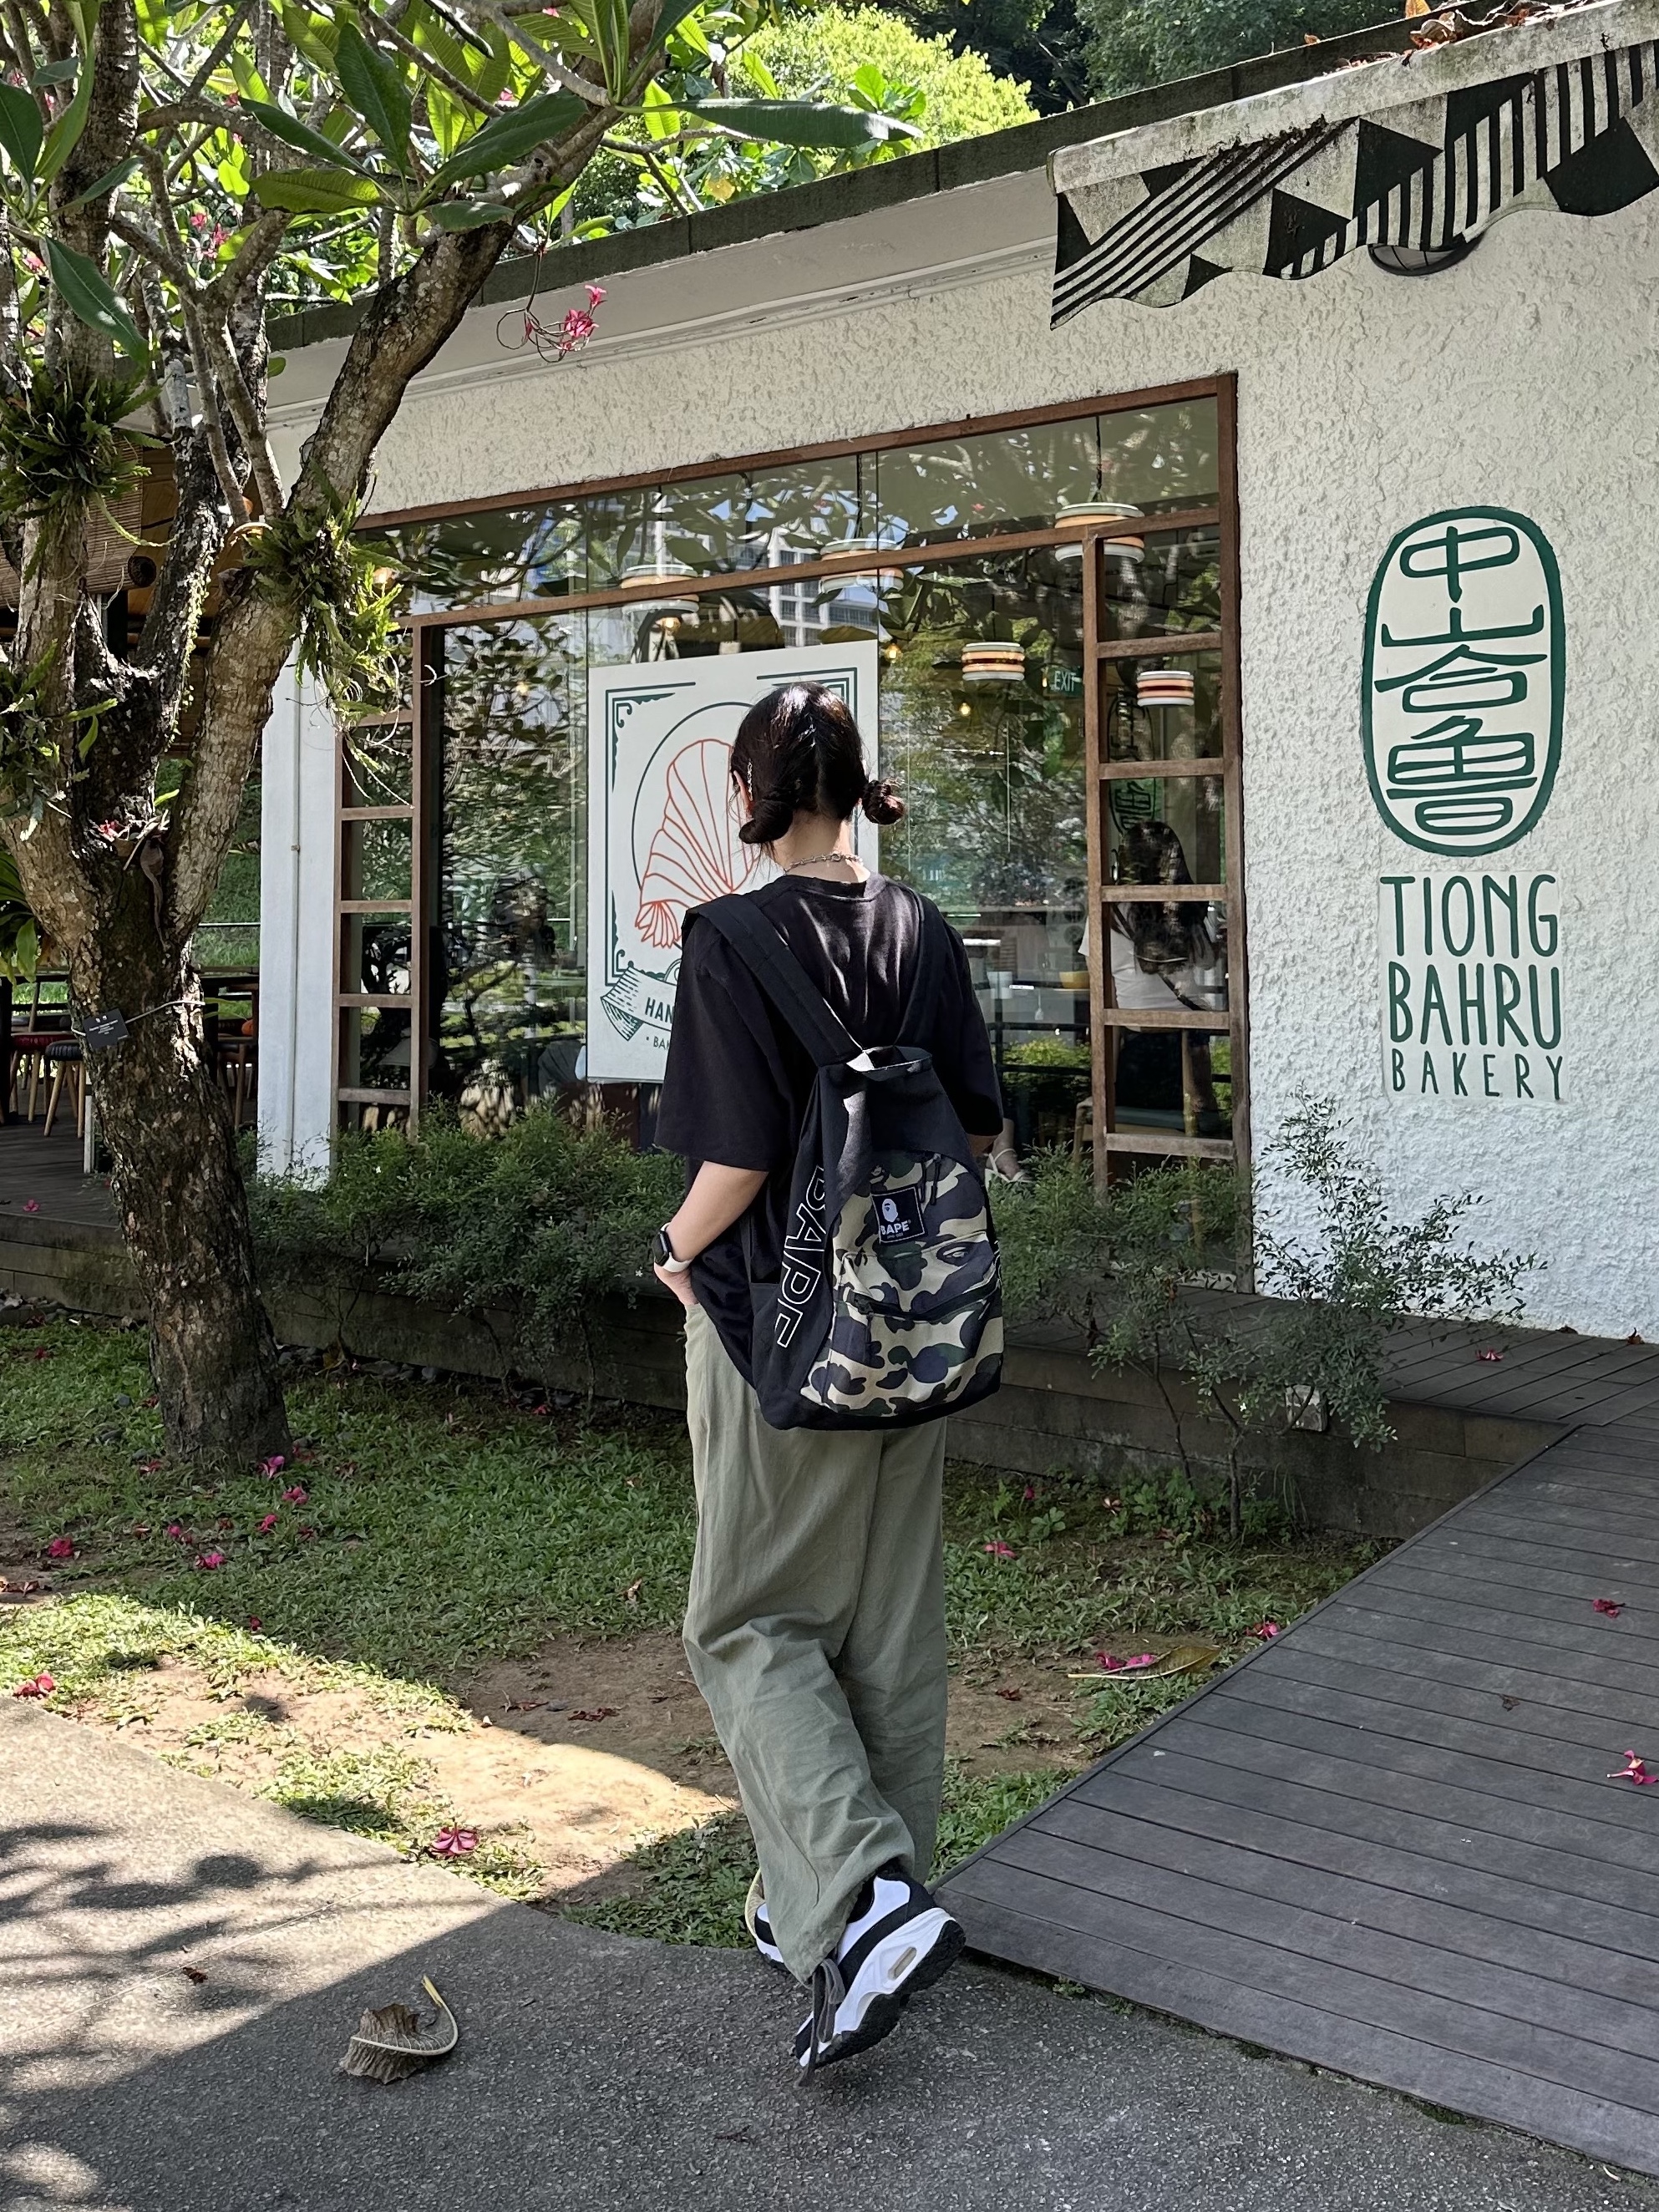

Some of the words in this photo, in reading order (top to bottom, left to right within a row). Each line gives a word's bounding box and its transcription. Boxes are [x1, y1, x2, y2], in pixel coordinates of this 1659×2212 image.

[1054, 670, 1077, 692] EXIT
[1380, 875, 1559, 960] TIONG
[1388, 961, 1562, 1051] BAHRU
[1392, 1048, 1564, 1101] BAKERY
[880, 1220, 910, 1235] BAPE
